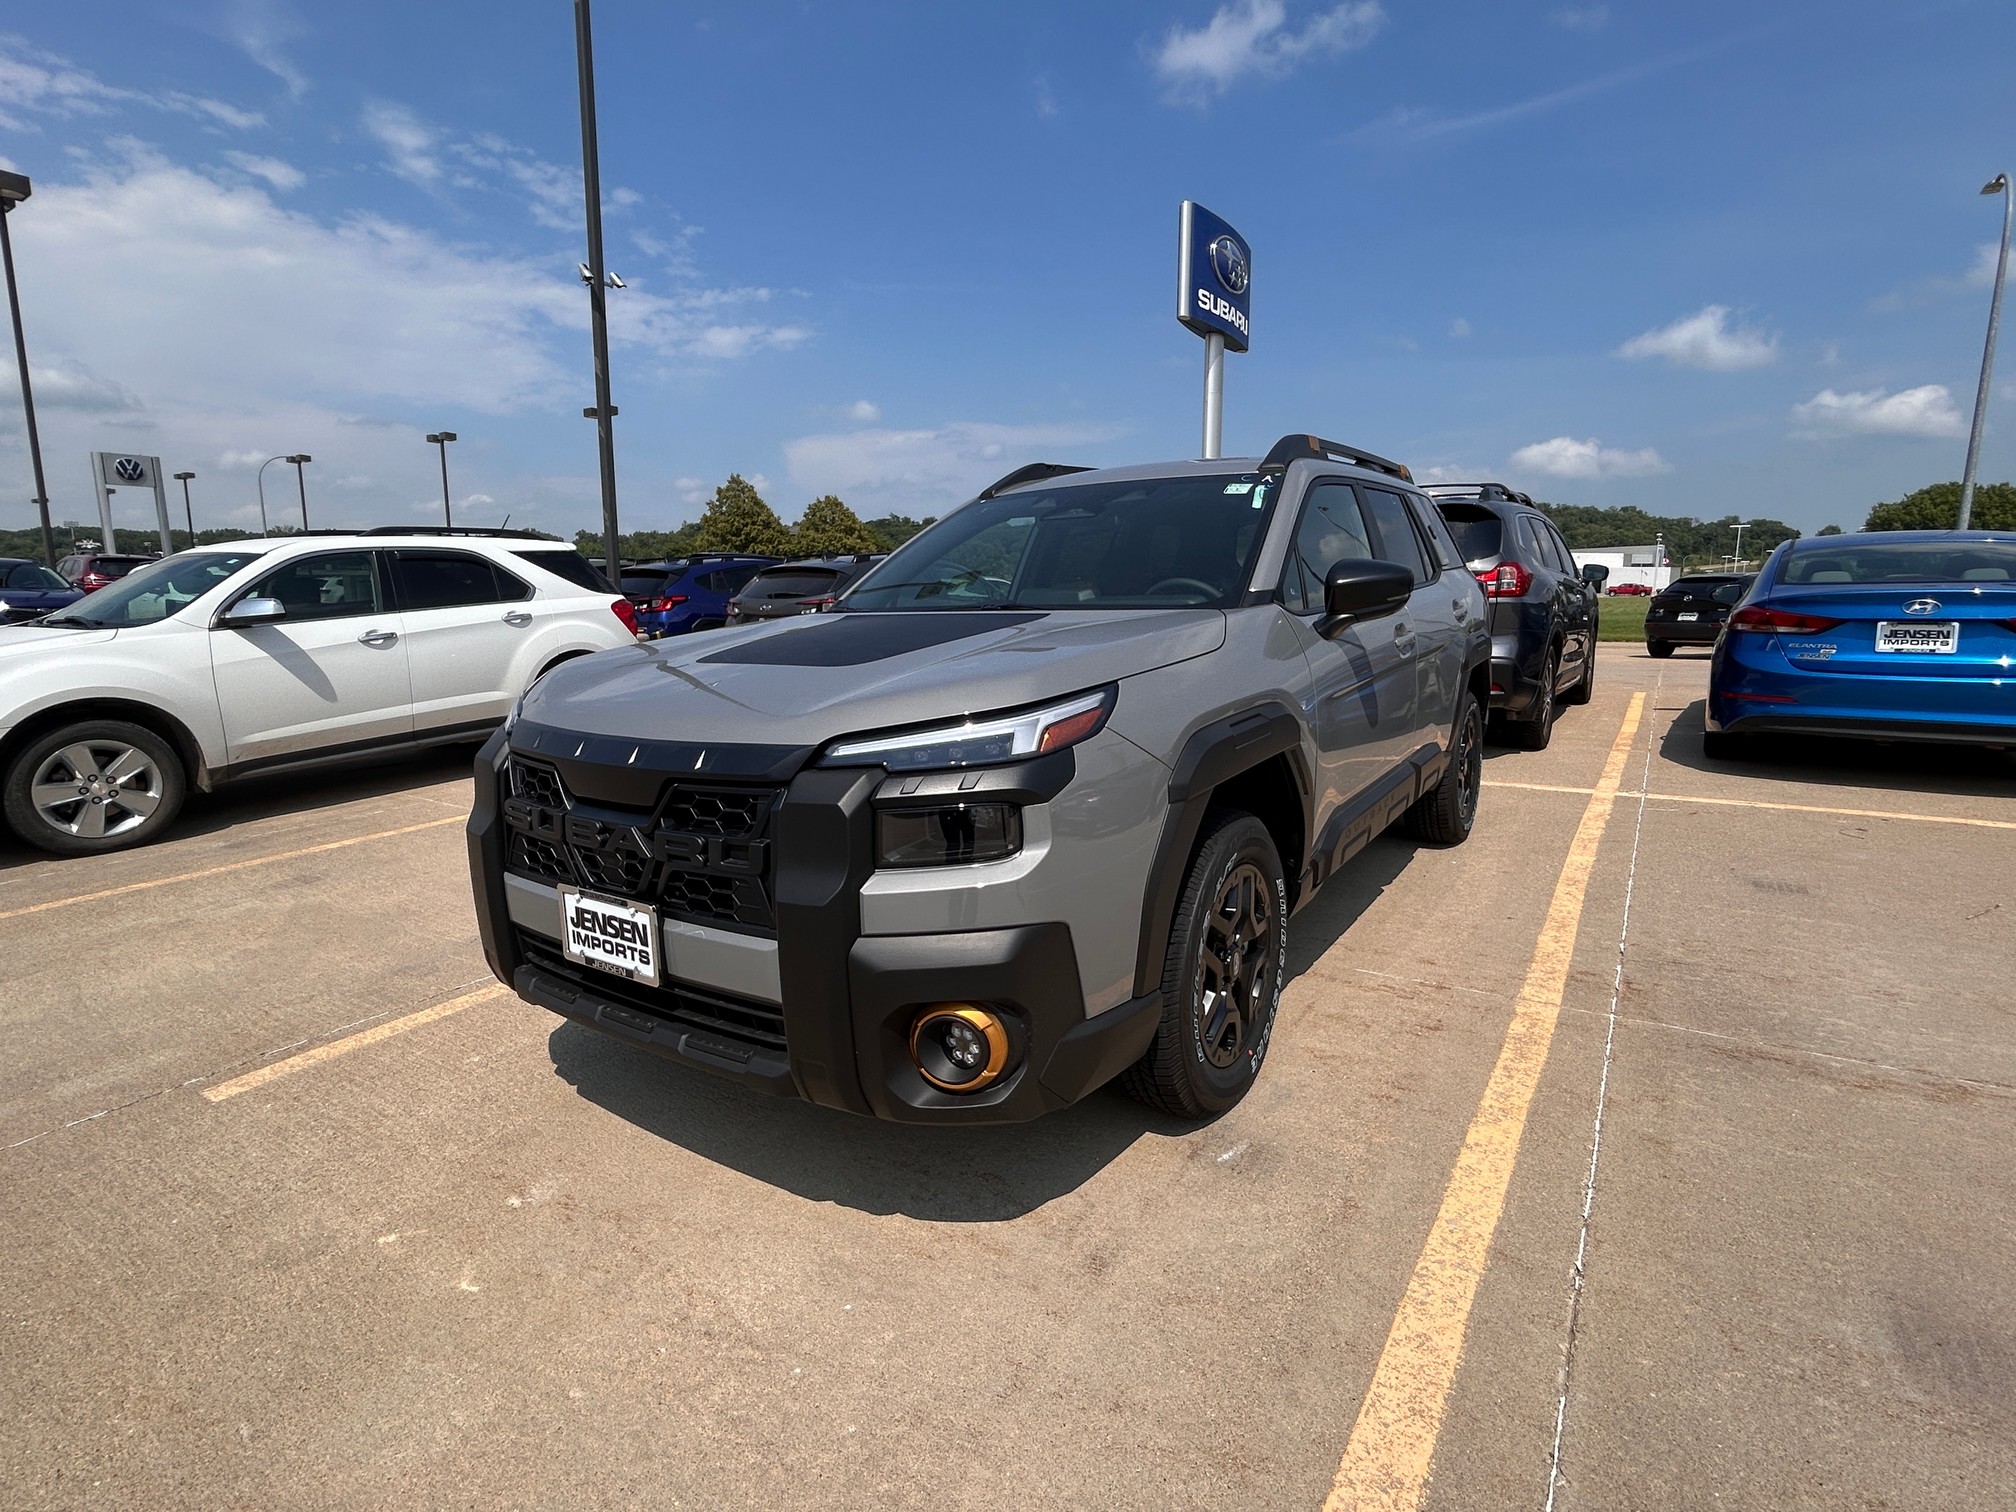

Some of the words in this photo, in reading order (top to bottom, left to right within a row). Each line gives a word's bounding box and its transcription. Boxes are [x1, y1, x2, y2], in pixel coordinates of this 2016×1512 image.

[1197, 288, 1249, 336] SUBARU
[1788, 642, 1838, 650] ELANTRA
[1883, 629, 1951, 639] JENSEN
[1883, 638, 1950, 647] IMPORTS
[504, 797, 771, 875] SUBARU
[570, 905, 649, 948] JENSEN
[571, 929, 651, 966] IMPORTS
[592, 960, 627, 978] JENSEN
